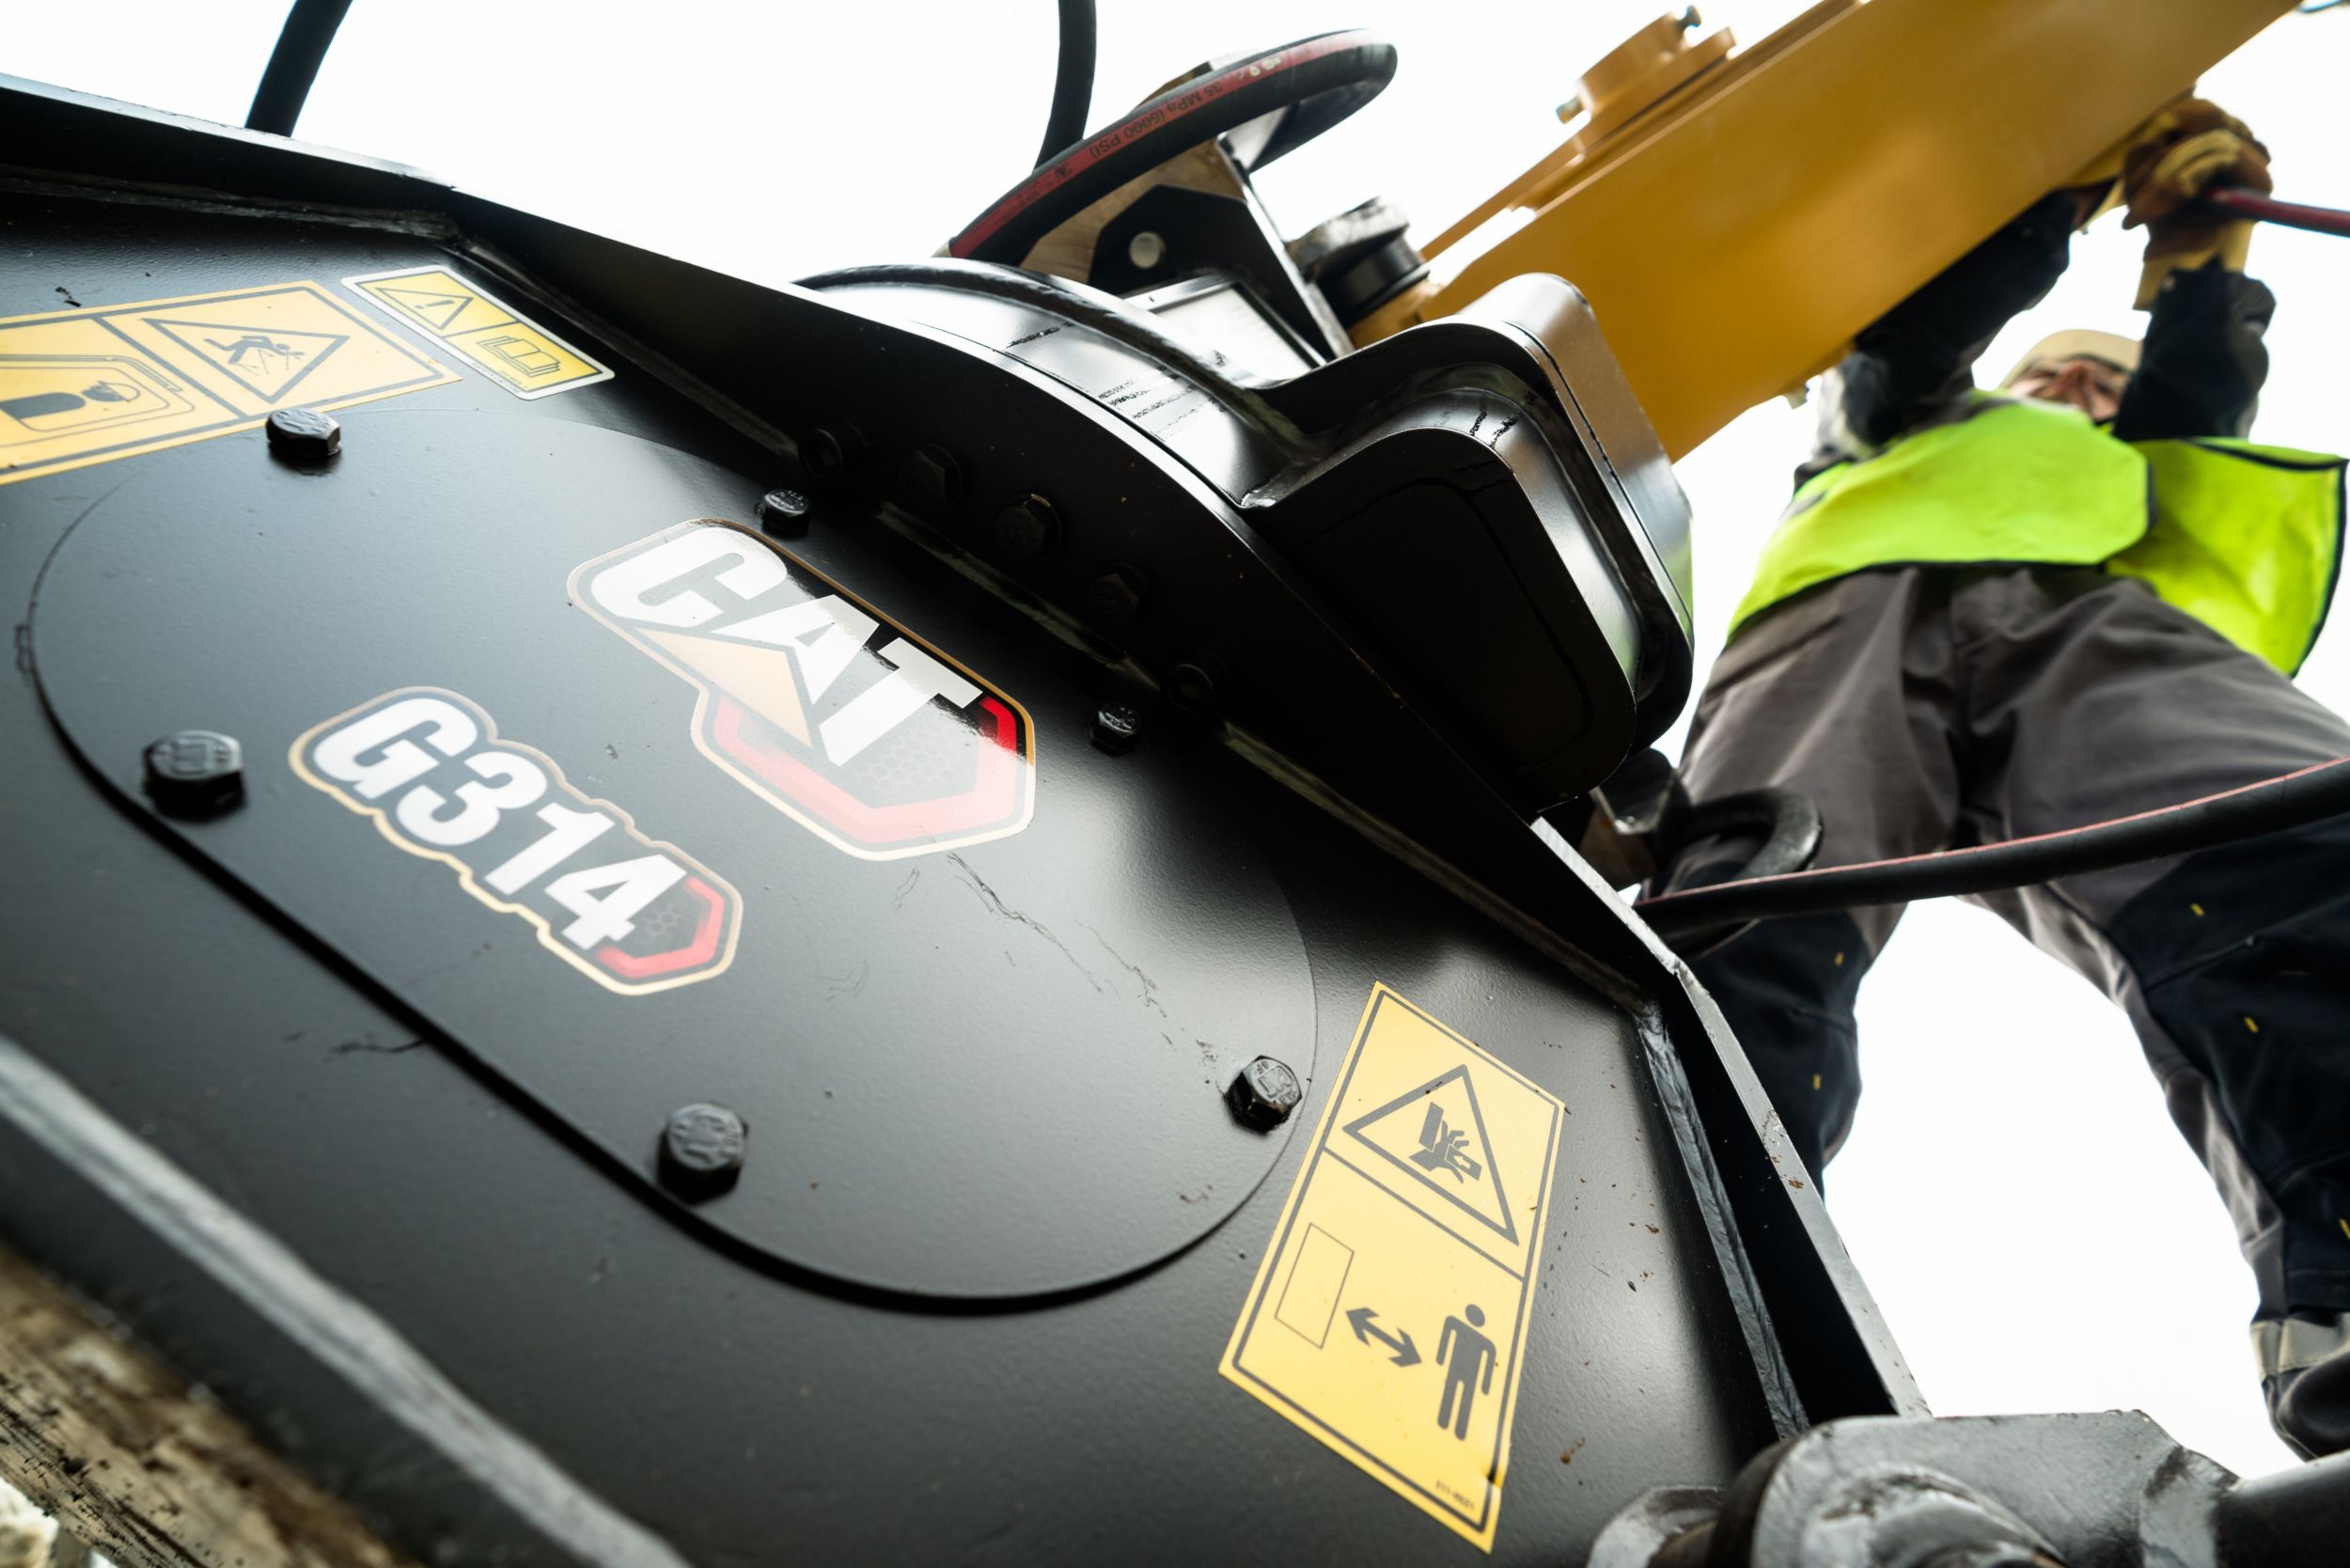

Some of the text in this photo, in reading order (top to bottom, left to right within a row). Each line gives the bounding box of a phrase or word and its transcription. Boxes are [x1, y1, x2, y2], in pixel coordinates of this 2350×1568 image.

[1205, 81, 1222, 96] 35
[1167, 91, 1202, 113] MPa
[1089, 133, 1121, 159] PSI)
[590, 526, 983, 767] CAT
[313, 697, 687, 951] G314
